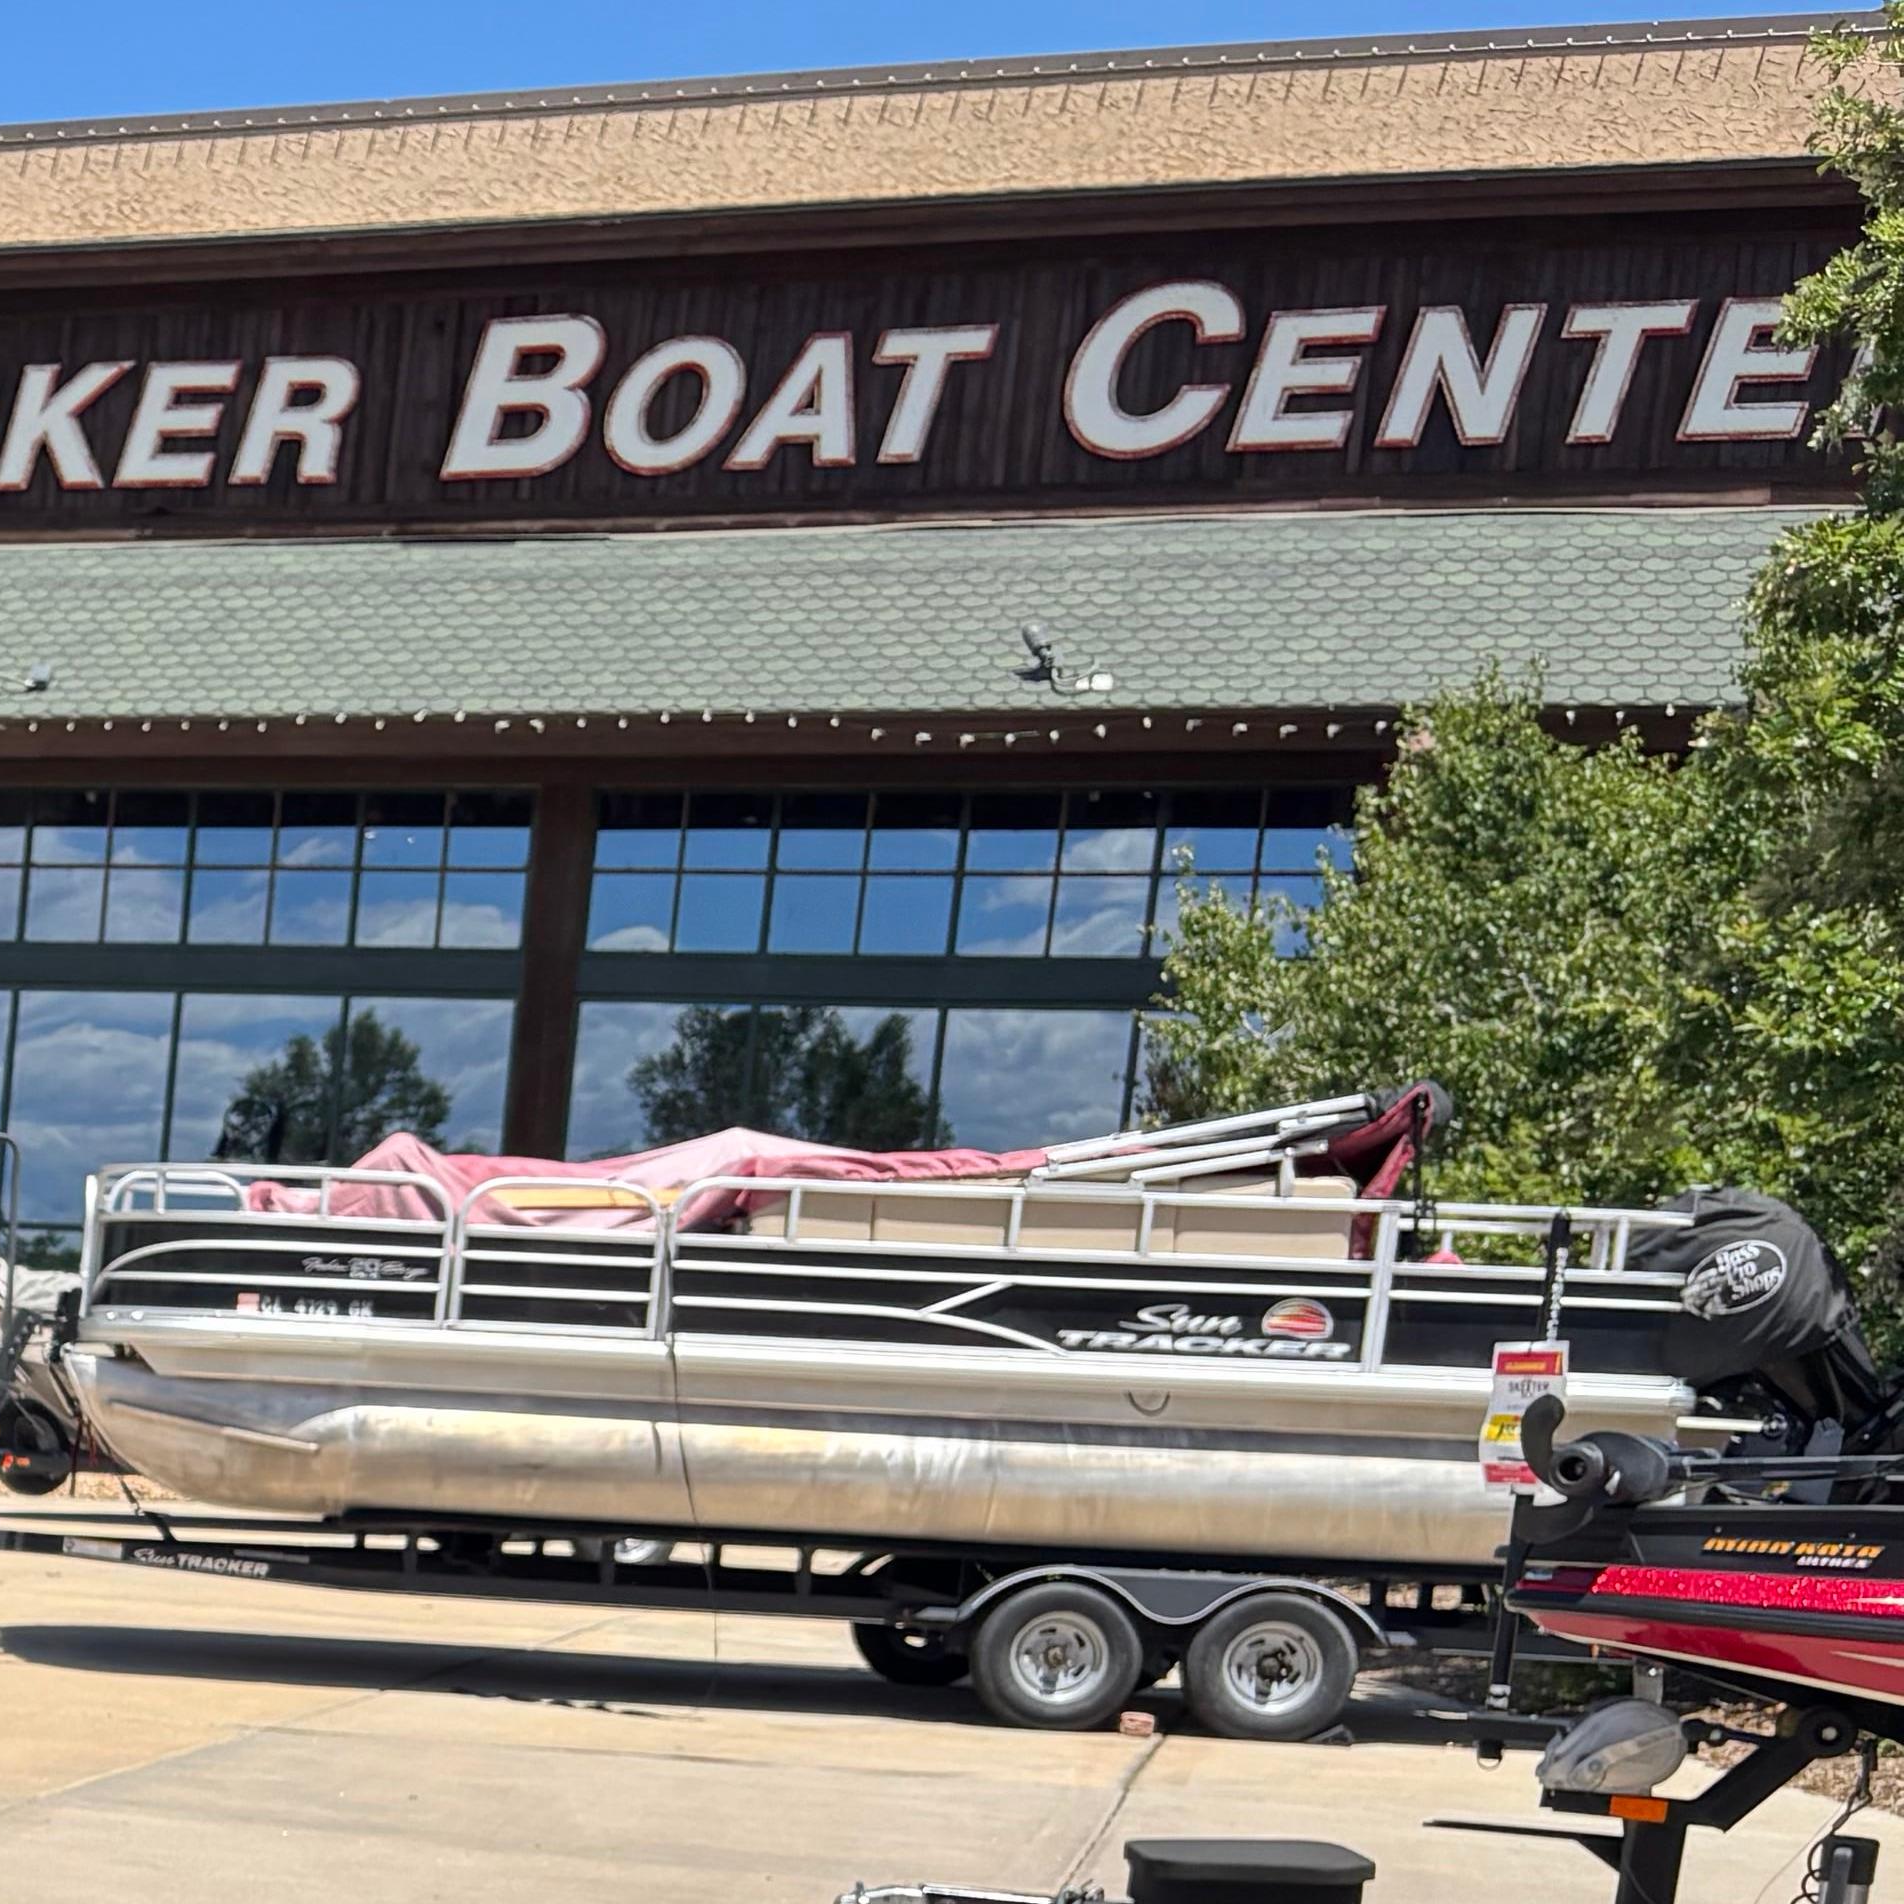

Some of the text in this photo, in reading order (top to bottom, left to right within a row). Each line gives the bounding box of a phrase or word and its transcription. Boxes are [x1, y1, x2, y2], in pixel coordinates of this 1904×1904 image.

[440, 311, 999, 482] BOAT
[1063, 278, 1884, 460] CENTE
[1118, 1303, 1243, 1336] Sun
[1056, 1329, 1351, 1358] TRACKER
[176, 1552, 270, 1579] TRACKER
